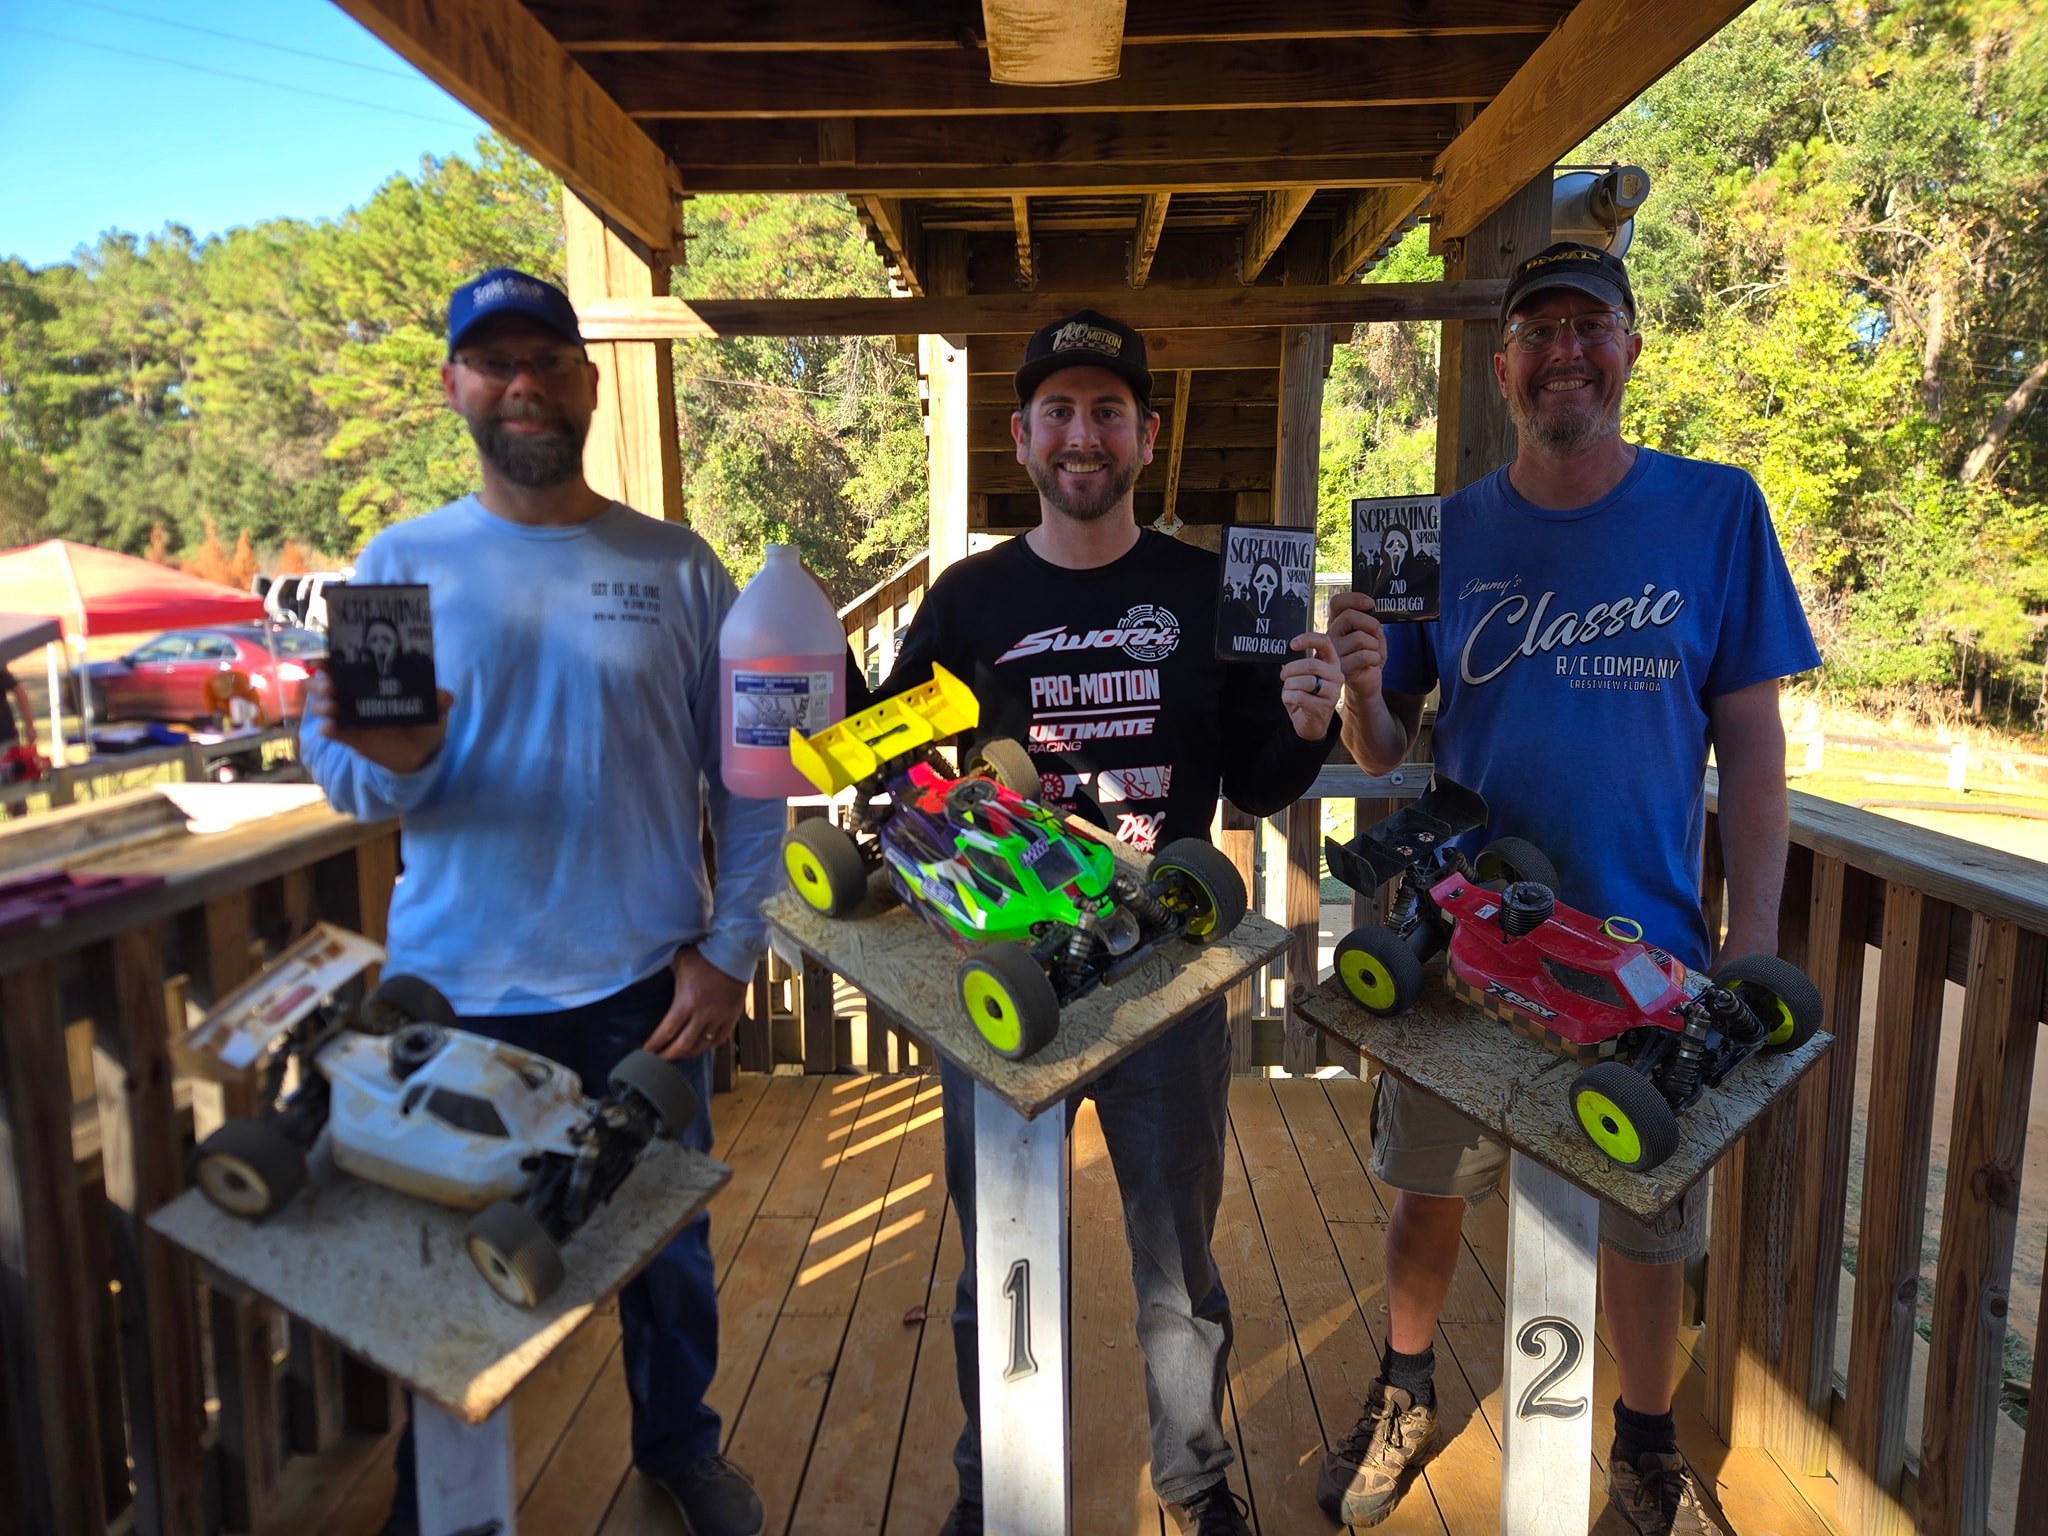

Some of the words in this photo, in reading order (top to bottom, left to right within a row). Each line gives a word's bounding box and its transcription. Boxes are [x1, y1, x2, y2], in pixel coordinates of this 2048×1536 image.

[1086, 331, 1122, 350] MOTION
[1358, 504, 1439, 534] SCREAMING
[1229, 536, 1311, 568] SCREAMING
[1286, 569, 1312, 584] SPRINT
[1389, 579, 1407, 595] 2ND
[1458, 574, 1522, 600] Jimmy's
[1398, 596, 1425, 612] BUGGY
[1255, 617, 1271, 635] 1ST
[1460, 583, 1684, 685] Classic
[1232, 635, 1259, 653] NITRO
[1259, 638, 1289, 655] BUGGY
[1555, 655, 1588, 676] R/C
[1593, 656, 1681, 679] COMPANY
[1030, 669, 1161, 708] PRO-MOTION
[1570, 679, 1621, 690] CRESTVIEW
[1623, 680, 1661, 692] FLORIDA
[1029, 717, 1155, 742] ULTIMATE
[1028, 741, 1082, 753] RACING
[1161, 764, 1172, 798] FUEL
[1484, 979, 1560, 1021] XRAY
[1003, 1258, 1038, 1383] 1
[1516, 1315, 1588, 1422] 2
